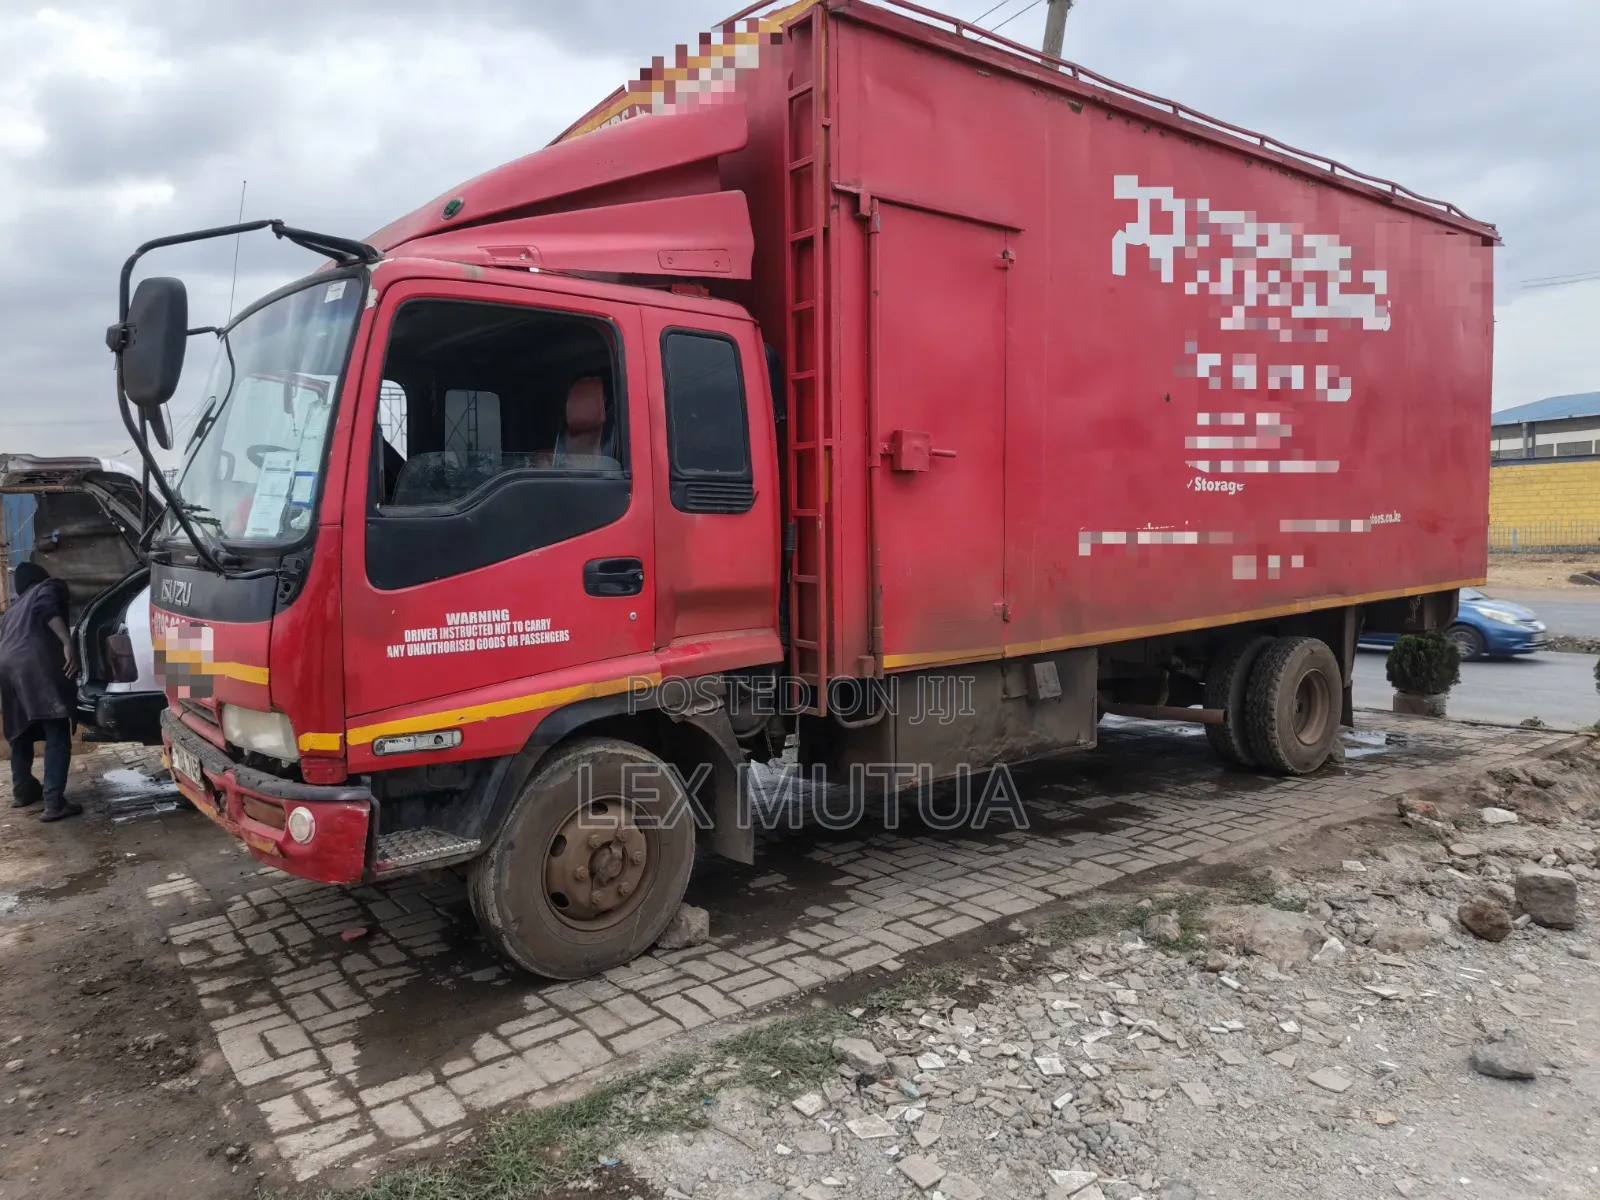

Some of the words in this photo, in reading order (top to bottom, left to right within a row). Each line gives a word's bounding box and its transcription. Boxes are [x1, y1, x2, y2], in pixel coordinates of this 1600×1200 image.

[1194, 476, 1245, 495] Storage
[160, 577, 192, 607] ISUZU
[404, 627, 438, 643] DRIVER
[439, 623, 493, 640] INSTRUCTED
[494, 621, 511, 635] NOT
[512, 620, 523, 634] TO
[524, 617, 551, 633] CARRY
[445, 608, 510, 626] WARNING
[387, 644, 405, 659] ANY
[406, 638, 475, 657] UNAUTHORISED
[476, 635, 506, 651] GOODS
[507, 634, 519, 647] OR
[519, 629, 570, 646] PASSENGERS
